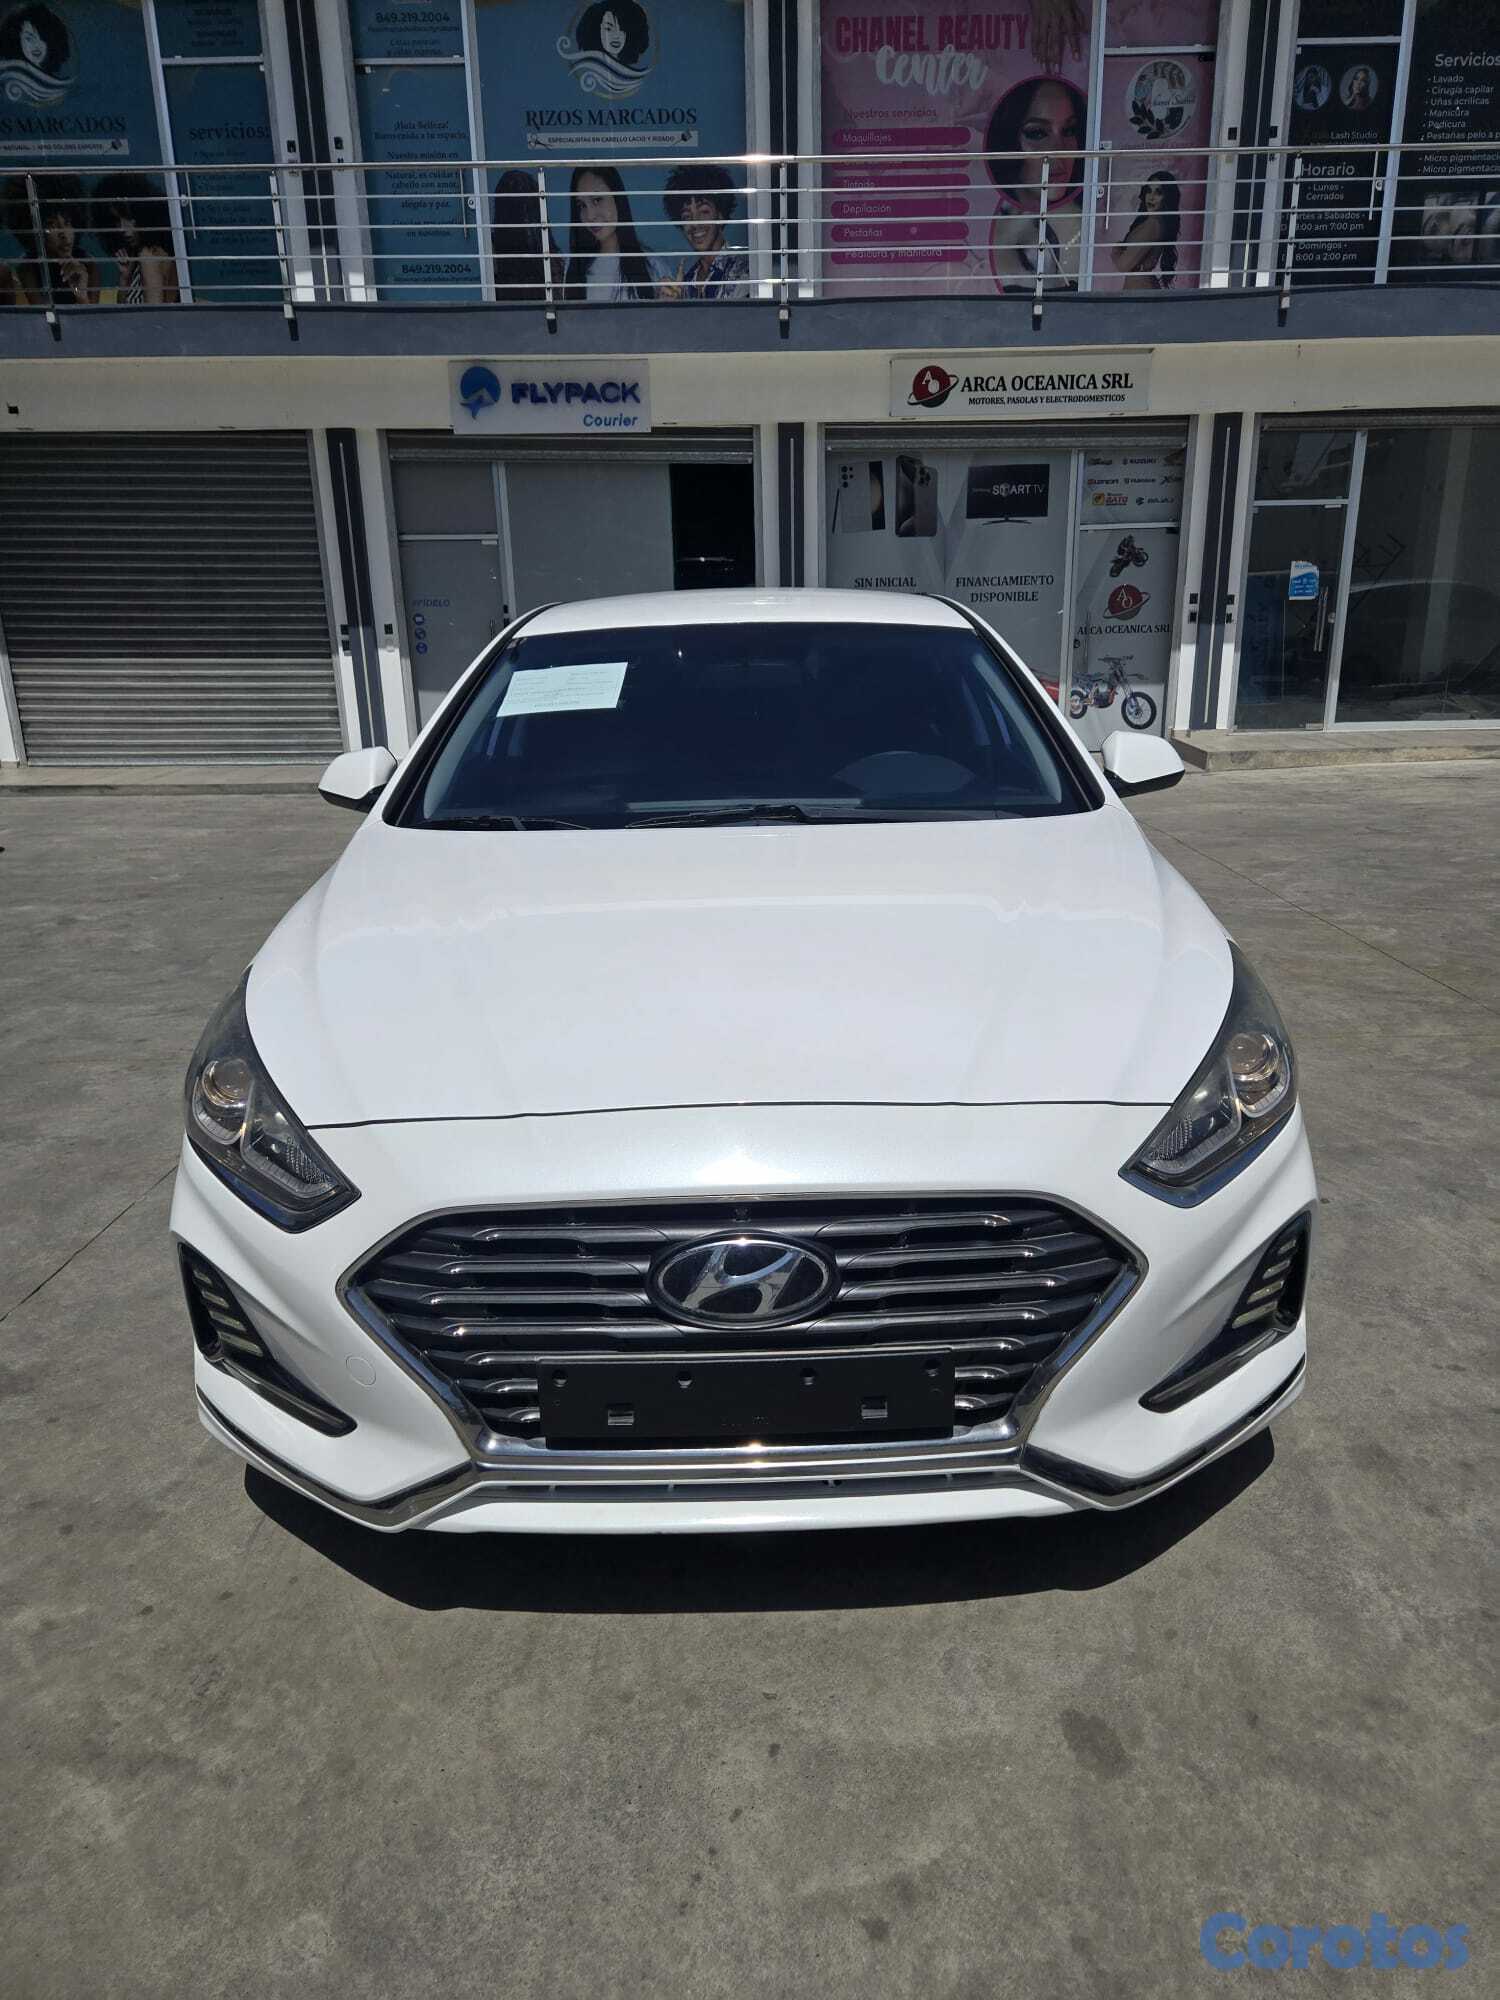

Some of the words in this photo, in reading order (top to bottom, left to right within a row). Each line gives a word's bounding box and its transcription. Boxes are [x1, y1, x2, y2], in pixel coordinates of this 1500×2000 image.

[835, 16, 930, 53] CHANEL
[938, 13, 1029, 51] BEAUTY
[875, 44, 988, 95] Center
[525, 108, 583, 130] RIZOS
[586, 107, 697, 127] MARCADOS
[1301, 160, 1356, 176] Horario
[1305, 192, 1345, 201] Cerrados
[960, 376, 1007, 393] ARCA
[1010, 374, 1099, 392] OCEANICA
[1100, 373, 1134, 389] SRL
[511, 382, 641, 404] FLYPACK
[583, 412, 639, 427] Courier
[854, 577, 873, 588] SIN
[875, 576, 917, 588] INICIAL
[955, 575, 1054, 588] FINANCIAMIENTO
[970, 590, 1039, 603] DISPONIBLE
[1104, 623, 1152, 634] OCEANICA
